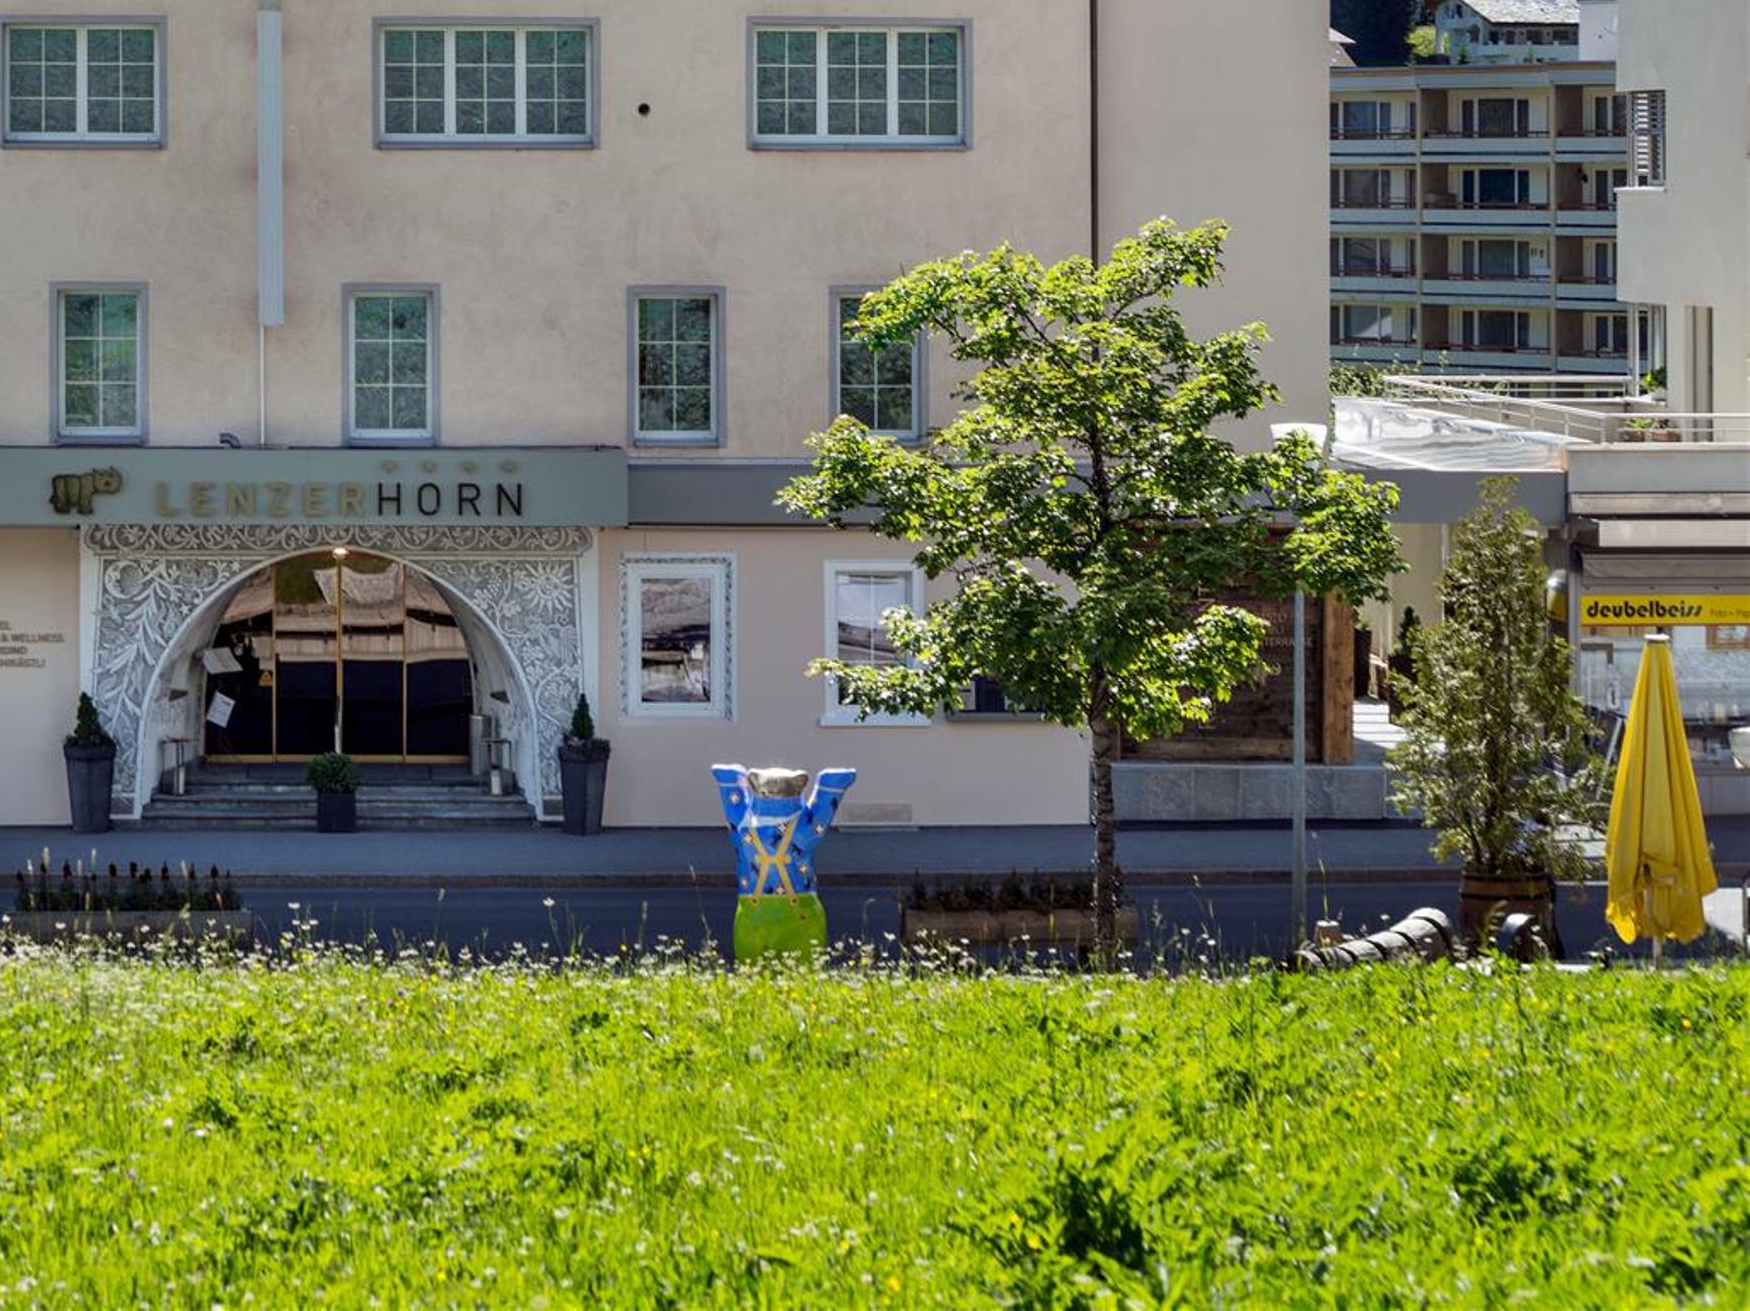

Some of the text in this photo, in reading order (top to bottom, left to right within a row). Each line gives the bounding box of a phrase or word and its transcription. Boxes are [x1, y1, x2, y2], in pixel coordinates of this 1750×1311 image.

[154, 480, 523, 518] LENZERHORN
[1587, 600, 1703, 618] deubelbeiss
[11, 633, 65, 643] WELLNESS
